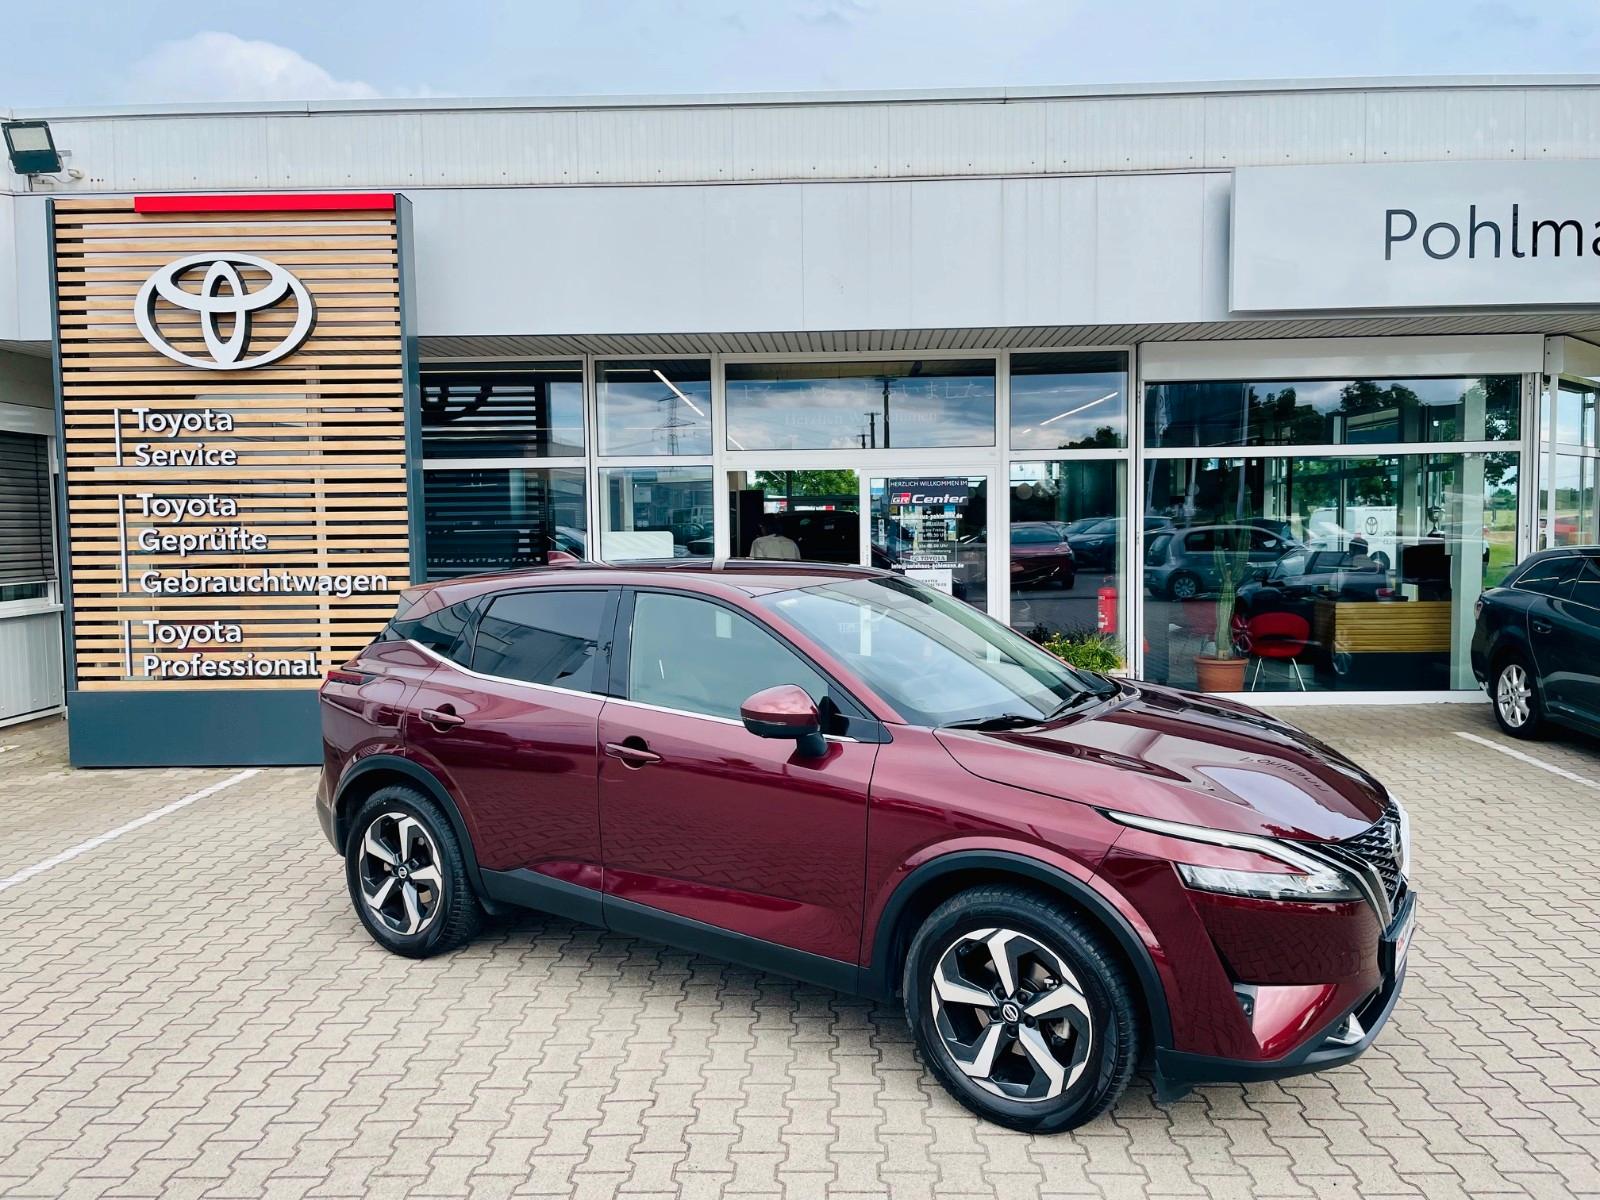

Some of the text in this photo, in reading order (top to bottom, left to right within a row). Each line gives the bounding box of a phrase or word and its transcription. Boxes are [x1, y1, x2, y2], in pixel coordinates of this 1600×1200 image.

[132, 407, 233, 438] Toyota
[134, 443, 238, 467] Service
[136, 494, 238, 523] Toyota
[892, 494, 968, 504] GR Center
[138, 529, 269, 557] Geprüfte
[140, 569, 389, 597] Gebrauchtwagen
[143, 620, 243, 649] Toyota
[143, 653, 319, 678] Professional
